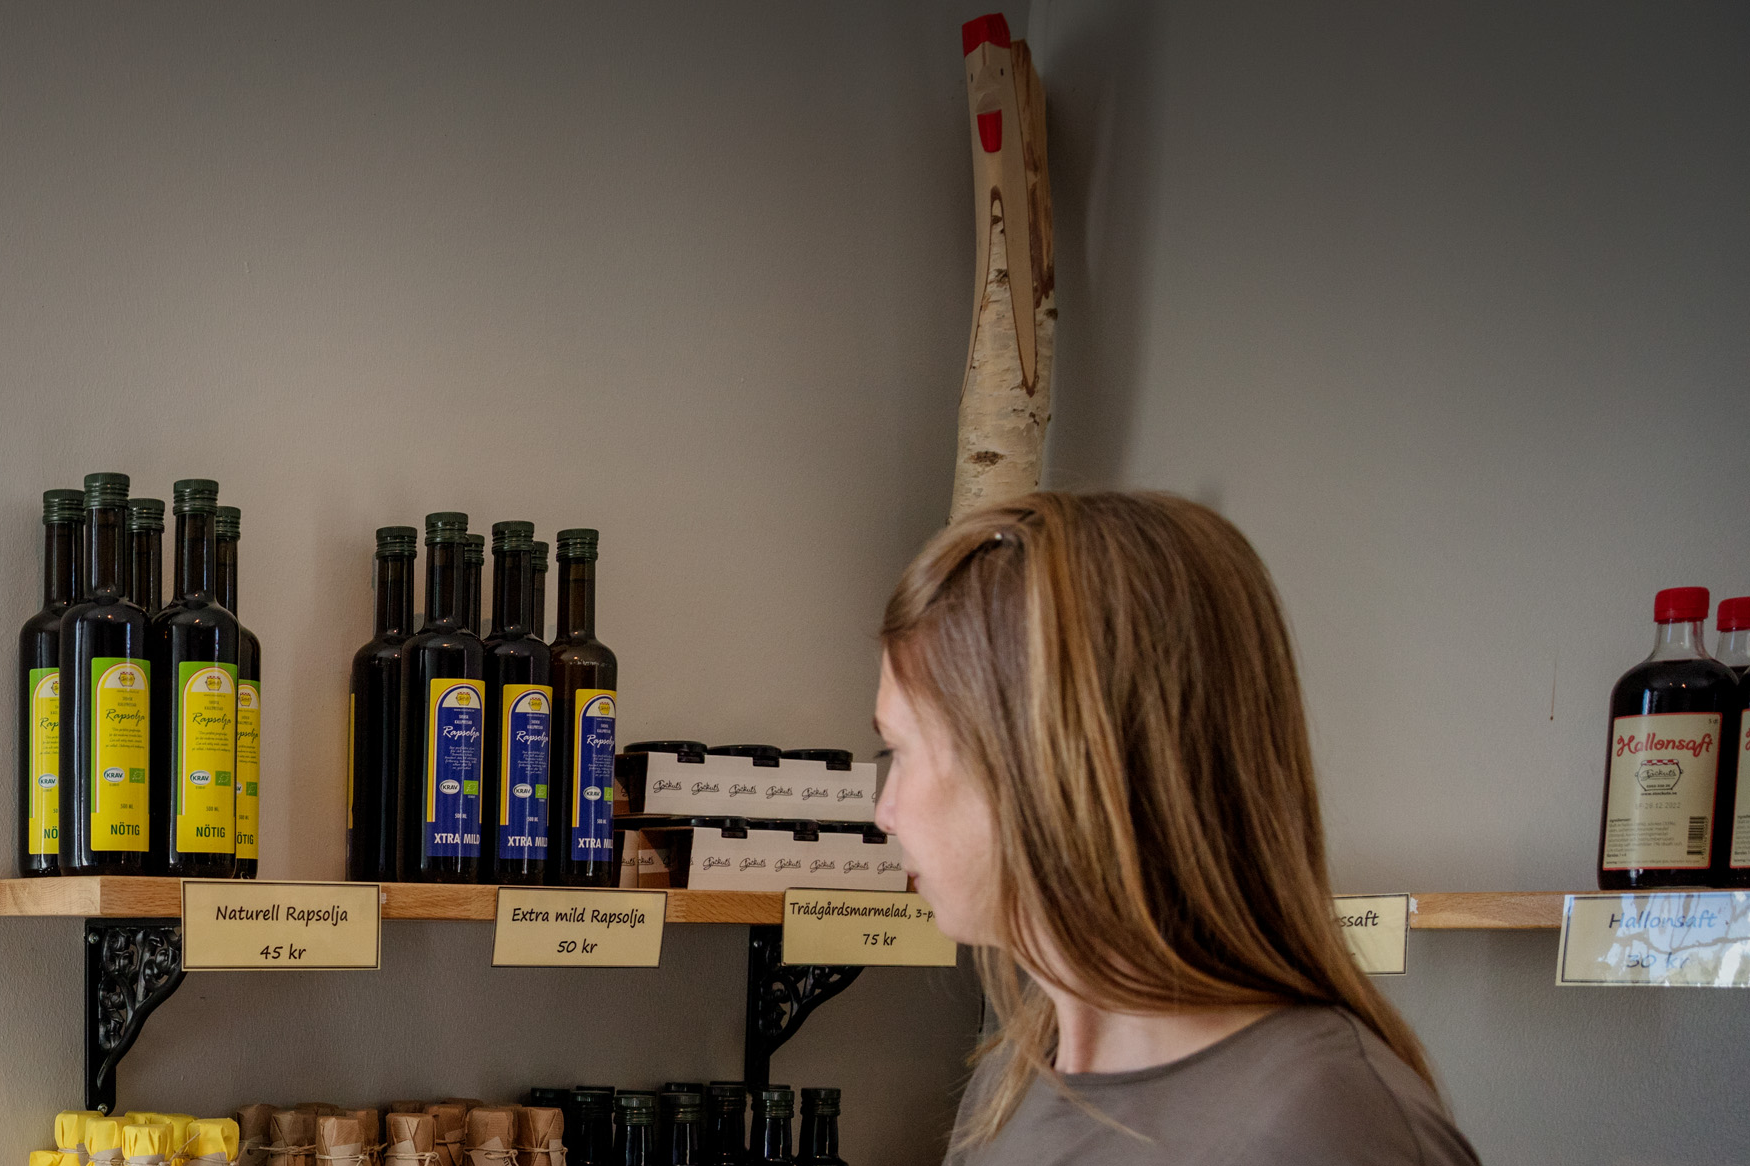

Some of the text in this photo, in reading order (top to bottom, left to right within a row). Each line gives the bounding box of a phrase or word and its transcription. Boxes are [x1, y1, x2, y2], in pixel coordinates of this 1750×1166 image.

[106, 708, 145, 727] Rapsolja
[193, 712, 232, 730] Rapsolja
[443, 725, 480, 743] Rapsolja
[516, 730, 549, 747] Rapsolja
[1616, 732, 1714, 757] Hallonsaft
[110, 822, 140, 836] NÖTIG
[196, 824, 225, 838] NÖTIG
[434, 833, 481, 845] XTRA MILD
[507, 836, 533, 847] XTRA
[578, 838, 601, 849] XTRA
[215, 904, 348, 927] Naturell Rapsolja
[511, 907, 645, 929] Extra mild Rapsolja
[789, 901, 912, 920] Trädgårdsmarmelad,
[1608, 909, 1718, 929] Hallonsaft
[556, 938, 598, 954] 50 kr
[863, 932, 897, 946] 75 kr
[260, 943, 306, 960] 45 kr
[1626, 952, 1690, 969] 30 kr
